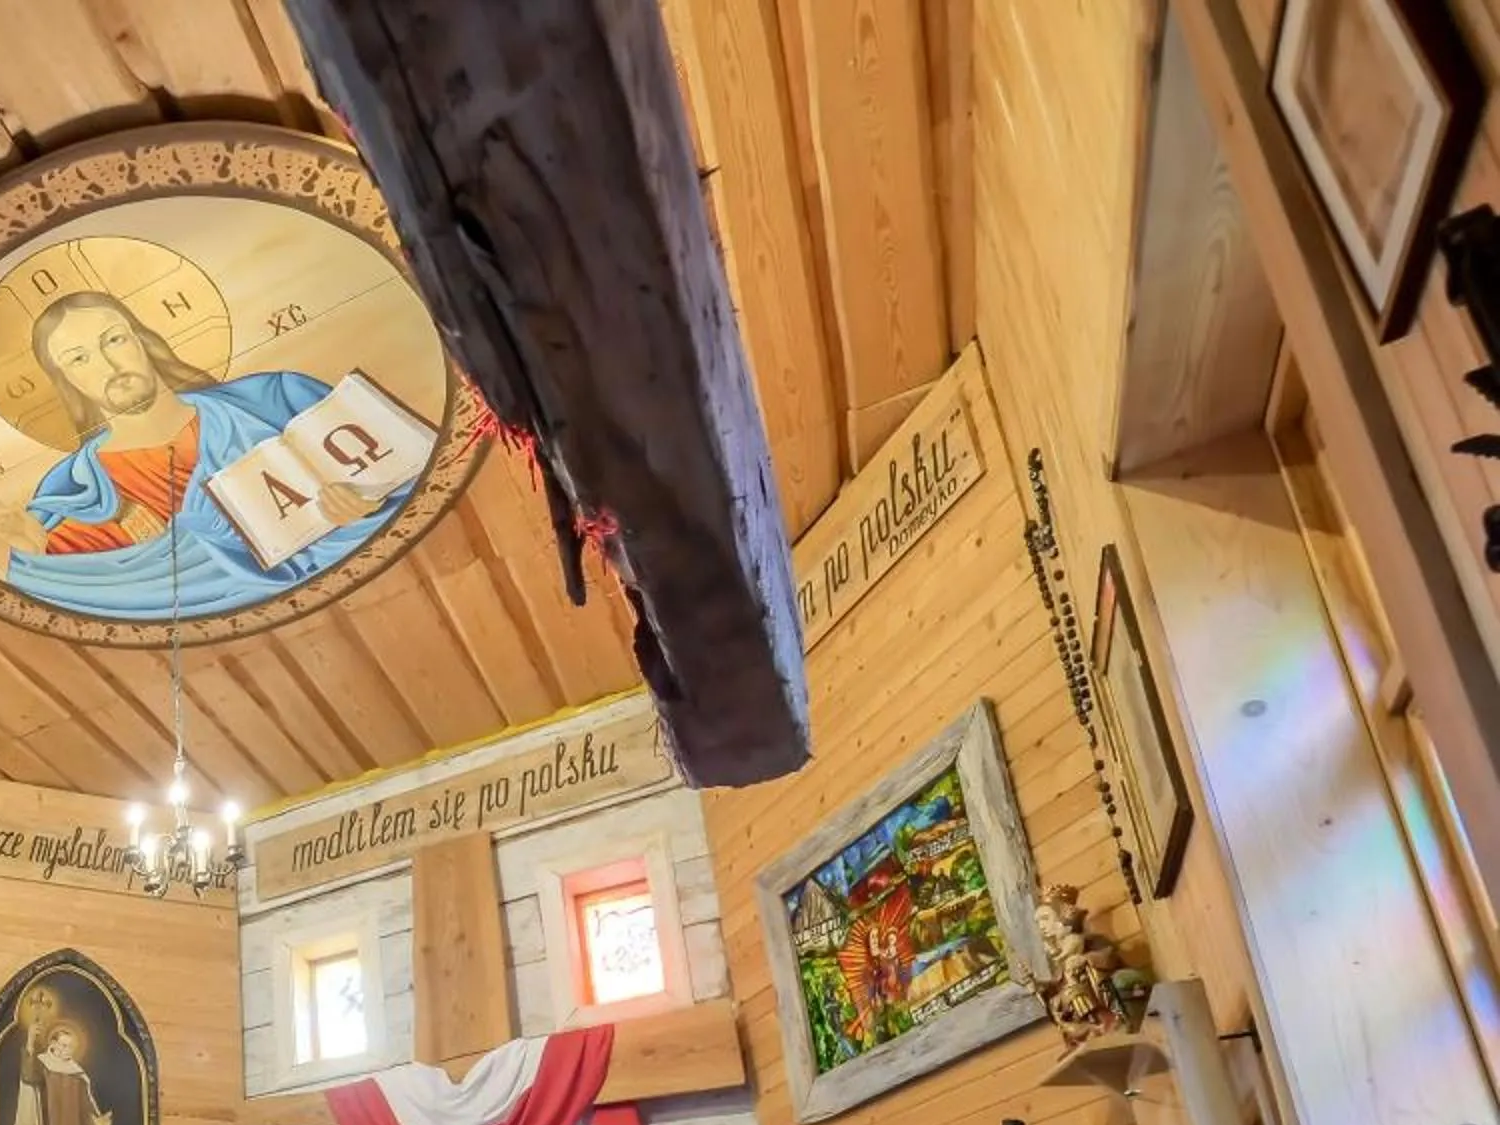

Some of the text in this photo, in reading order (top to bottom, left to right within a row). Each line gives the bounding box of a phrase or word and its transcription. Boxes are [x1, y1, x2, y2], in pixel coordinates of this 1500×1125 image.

[823, 541, 850, 618] po
[429, 788, 466, 830] się
[477, 776, 510, 829] po
[519, 732, 620, 817] polsku
